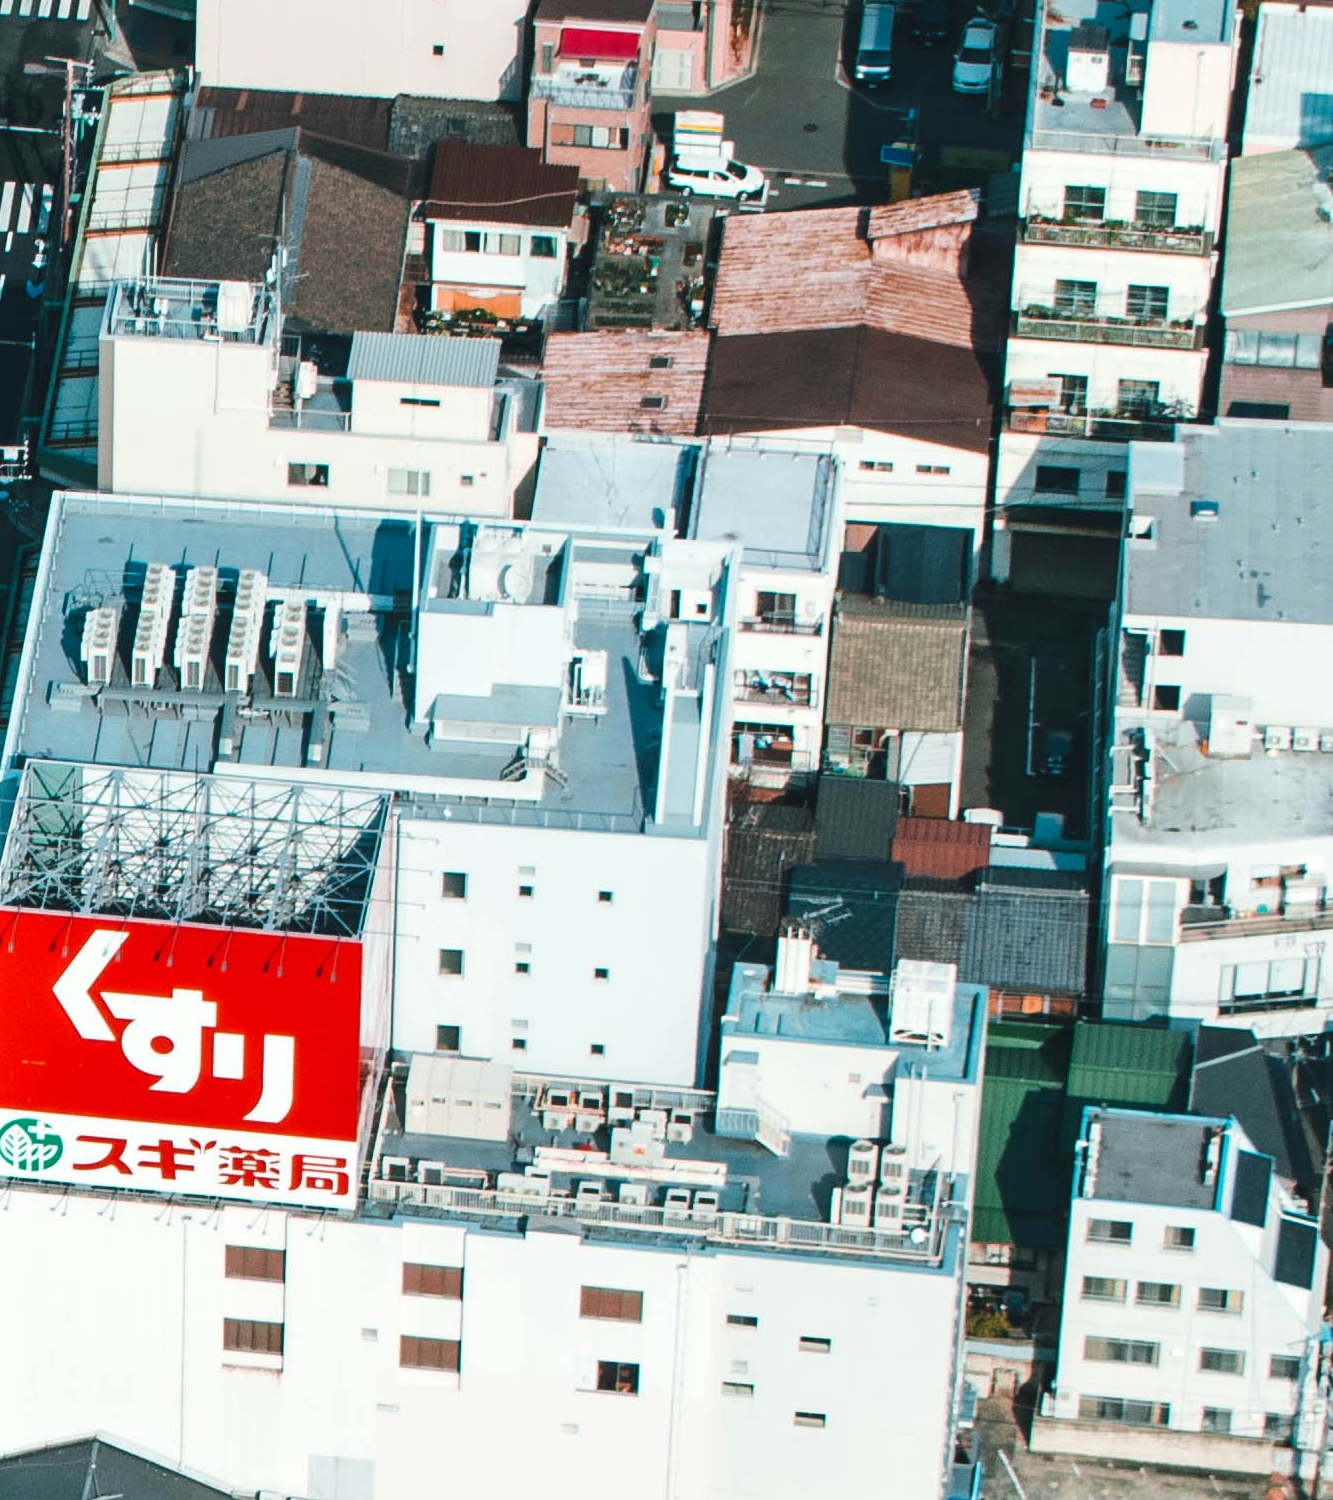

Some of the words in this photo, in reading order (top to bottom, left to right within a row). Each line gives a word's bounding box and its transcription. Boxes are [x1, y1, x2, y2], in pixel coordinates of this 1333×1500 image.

[52, 929, 297, 1124] くすり
[72, 1132, 349, 1197] スギ薬局
